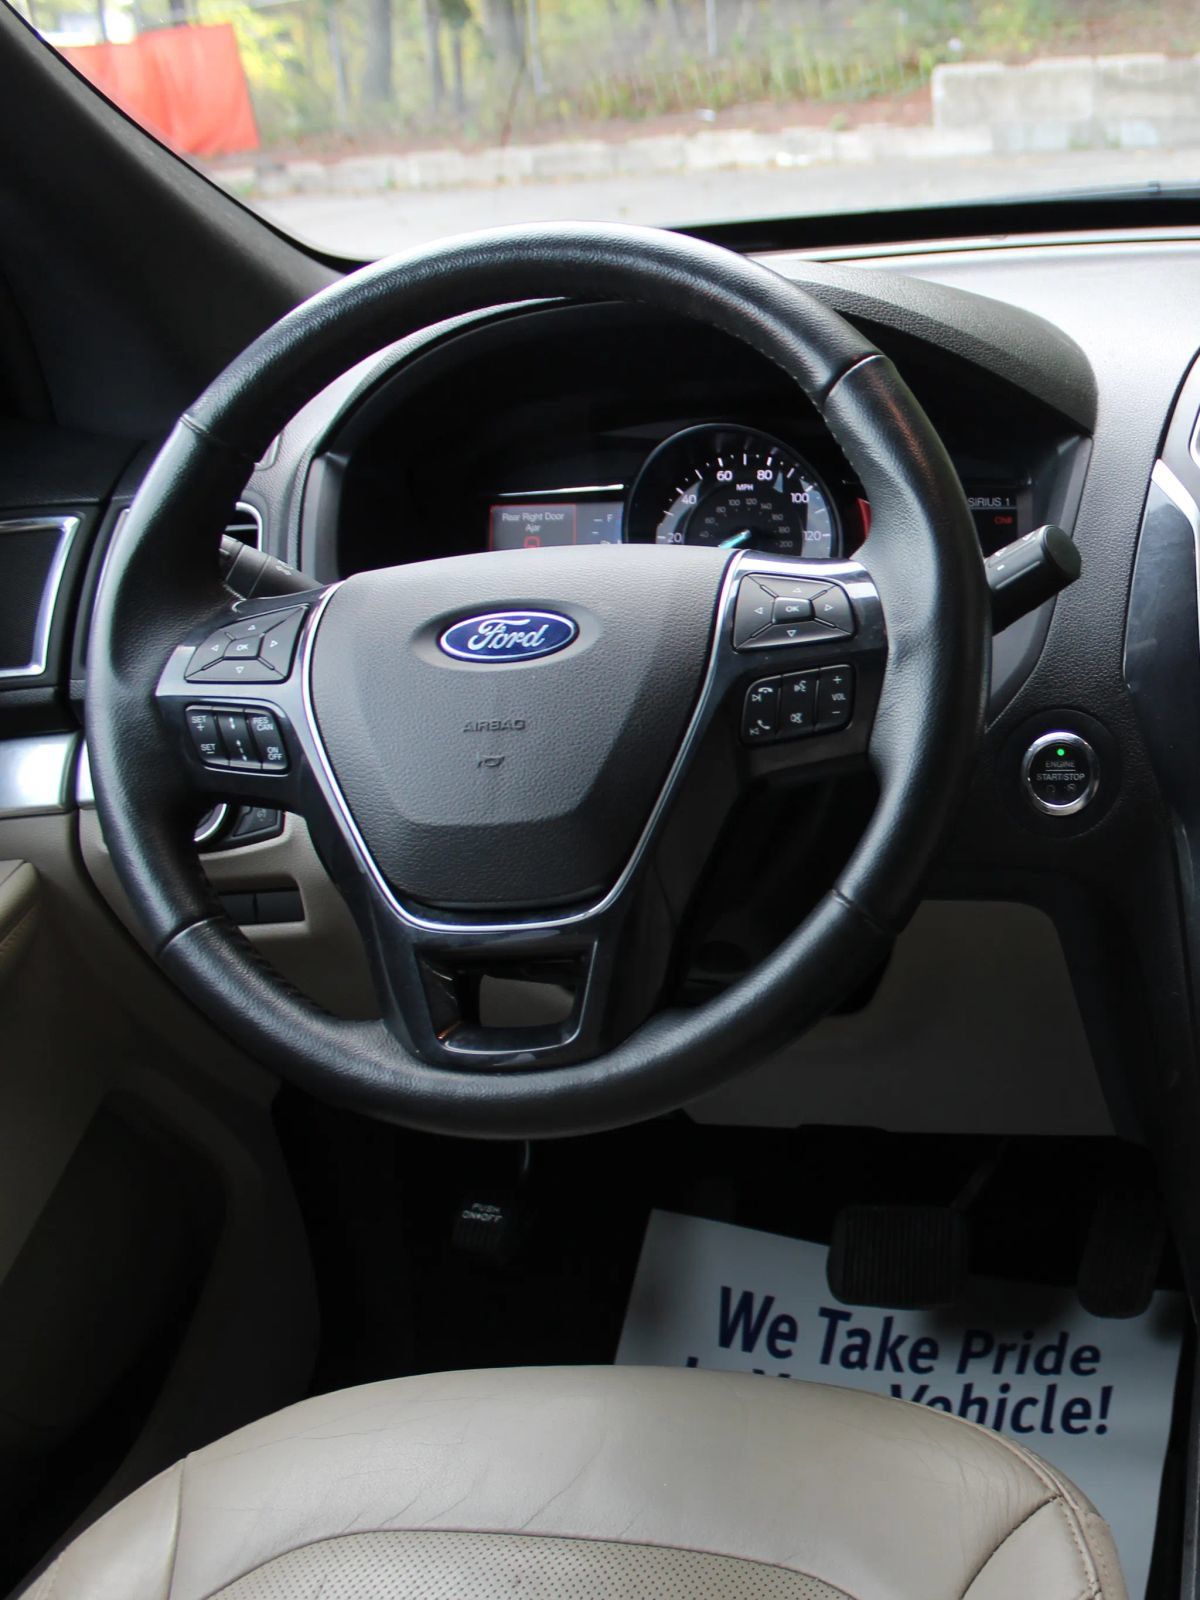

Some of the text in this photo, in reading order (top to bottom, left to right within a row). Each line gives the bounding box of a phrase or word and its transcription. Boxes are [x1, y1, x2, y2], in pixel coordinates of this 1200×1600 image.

[716, 470, 733, 482] 60
[756, 469, 773, 481] 80
[735, 483, 753, 491] MPH
[682, 494, 697, 505] 40
[790, 492, 810, 504] 100
[967, 497, 1010, 507] SIRIUS 1
[502, 512, 565, 522] Rear Right Door
[525, 524, 541, 533] Ajar
[667, 532, 682, 543] 20
[803, 530, 821, 541] 120
[785, 605, 800, 613] OK
[467, 618, 549, 651] Ford
[236, 643, 249, 651] OK
[832, 692, 846, 701] VOL
[191, 715, 207, 724] SET
[252, 716, 269, 725] RES
[256, 723, 274, 731] CAN
[463, 719, 527, 733] AIRBAG
[200, 743, 216, 751] SET
[267, 746, 279, 754] ON
[268, 753, 283, 761] OFF
[716, 1285, 1102, 1378] We Take Pride
